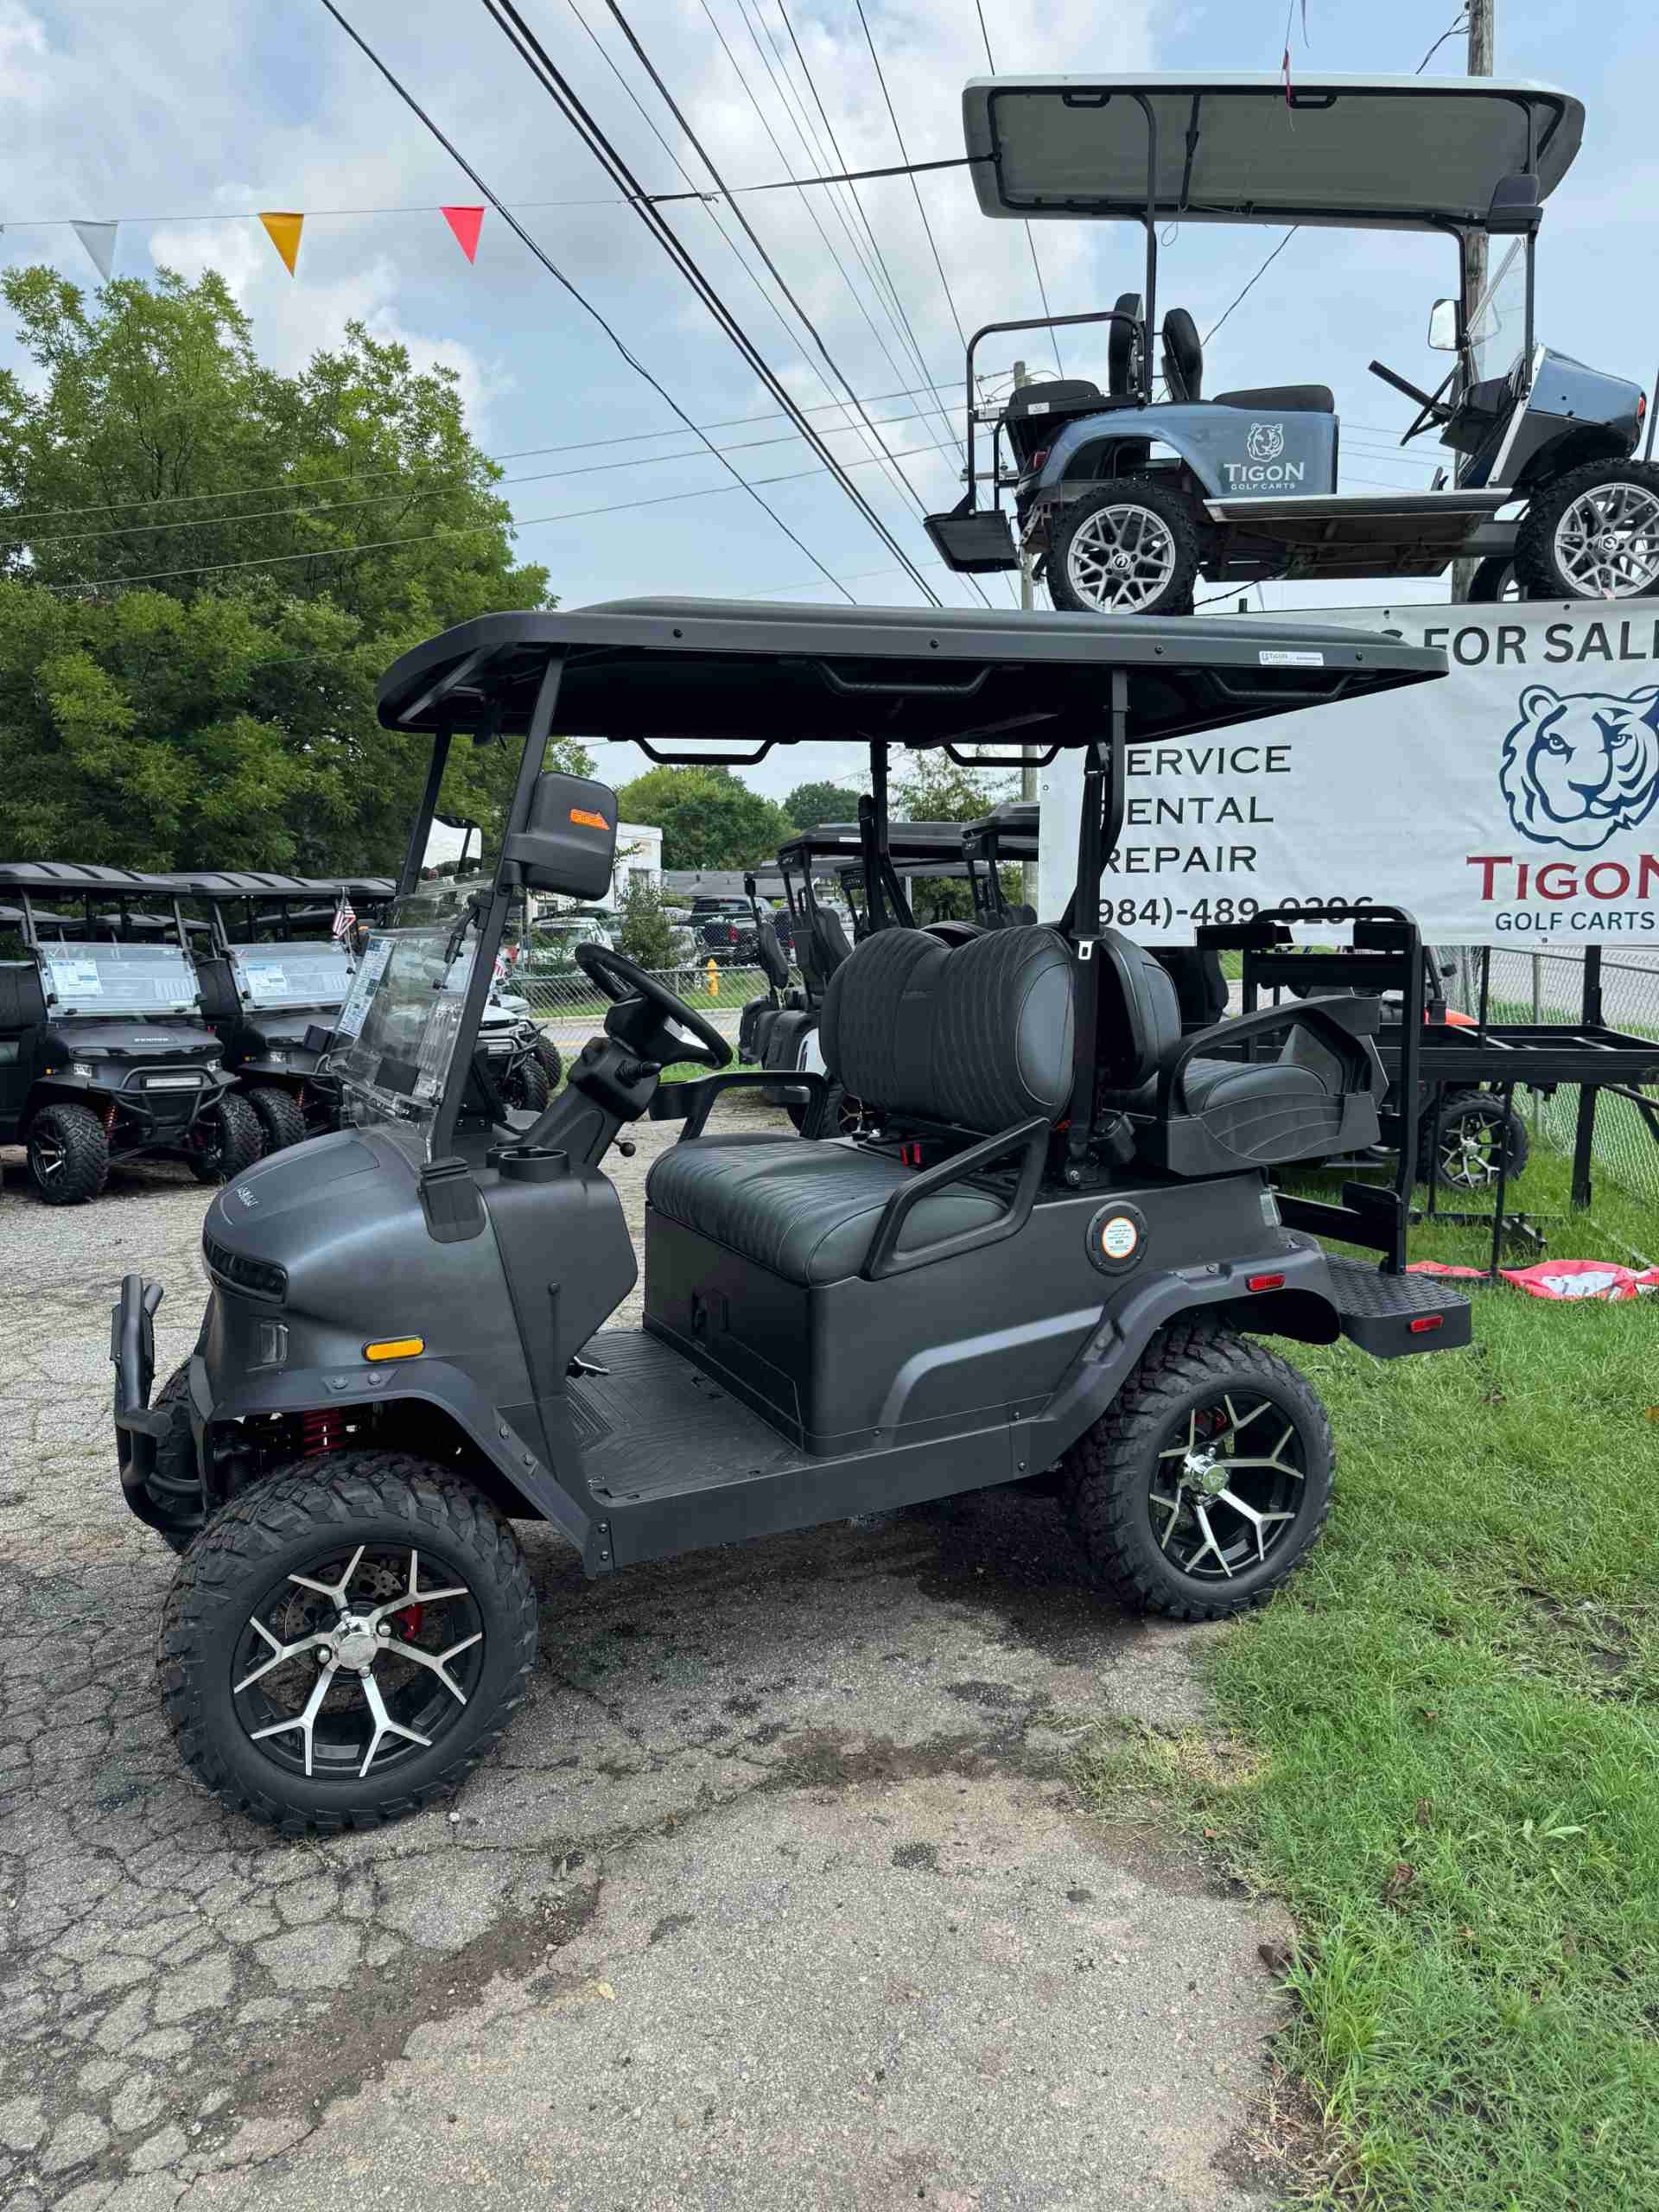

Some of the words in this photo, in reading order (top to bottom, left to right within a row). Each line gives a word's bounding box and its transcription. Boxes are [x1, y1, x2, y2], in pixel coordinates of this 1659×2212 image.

[1224, 462, 1305, 481] TIGON
[1127, 745, 1292, 776] ERVICE
[1127, 796, 1274, 825] ENTAL
[1495, 912, 1563, 931] GOLF
[1570, 912, 1656, 931] CARTS
